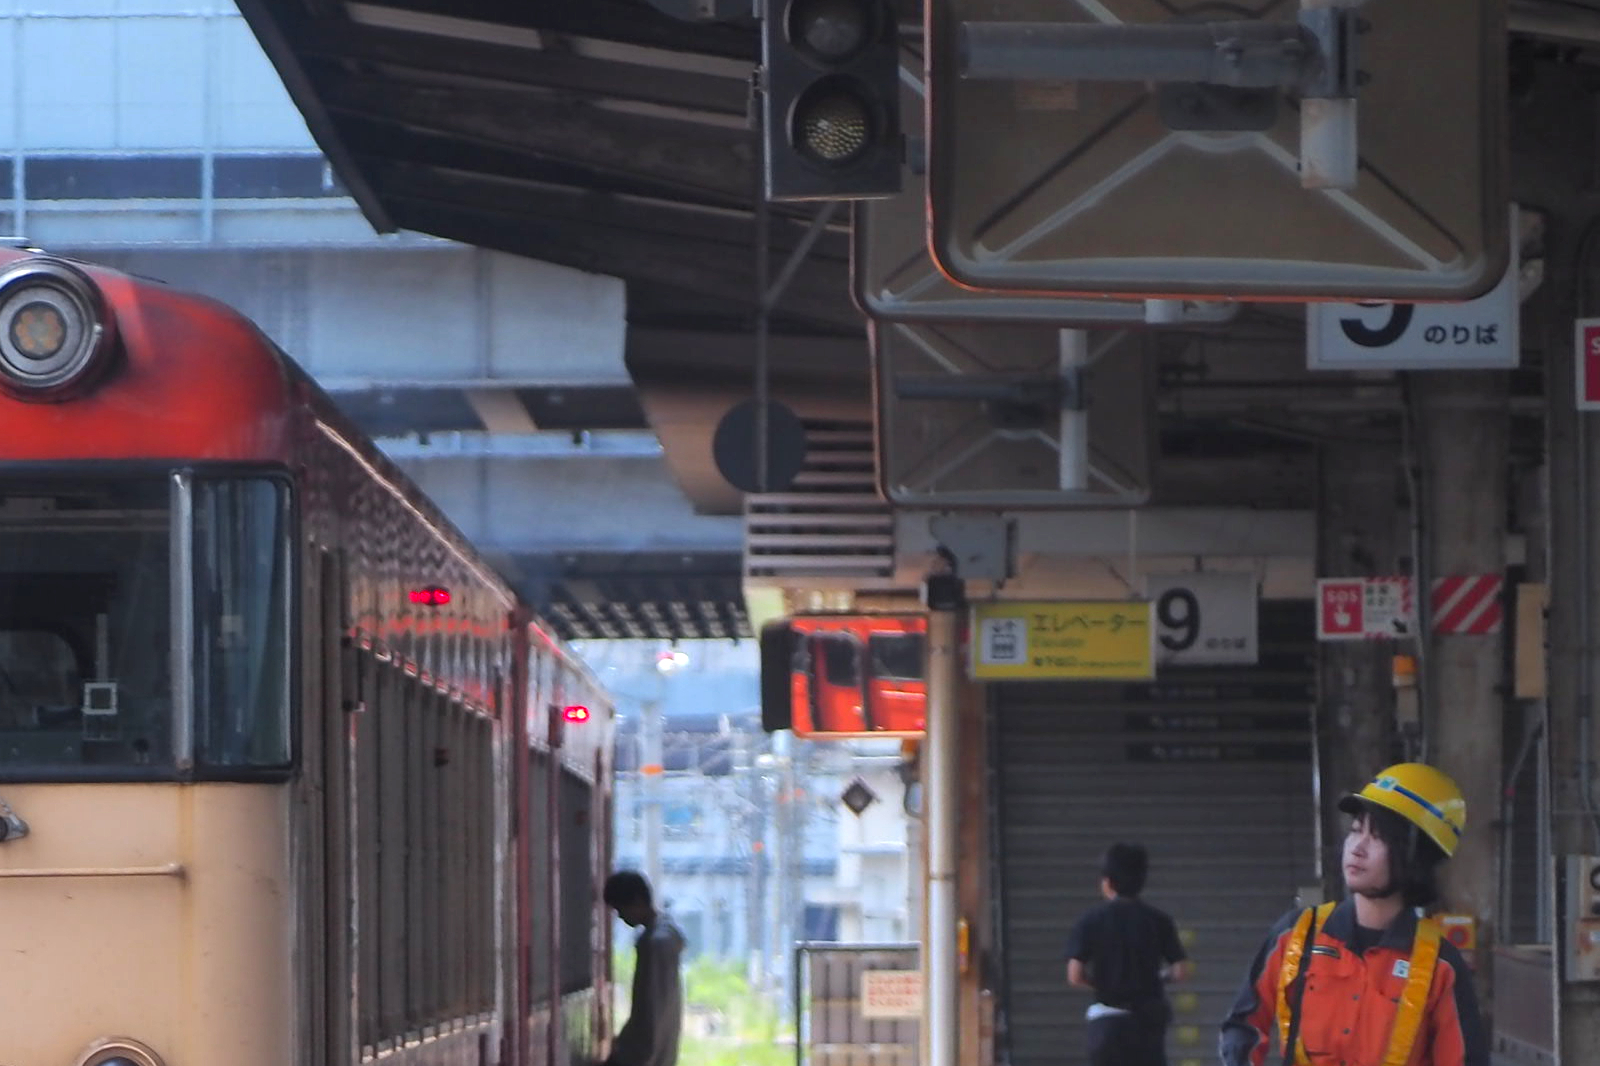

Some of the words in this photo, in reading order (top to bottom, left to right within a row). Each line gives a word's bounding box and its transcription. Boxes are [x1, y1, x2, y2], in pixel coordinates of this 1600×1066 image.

[1424, 324, 1498, 344] のりば
[1032, 613, 1146, 633] エレベーター
[1157, 587, 1199, 651] 9
